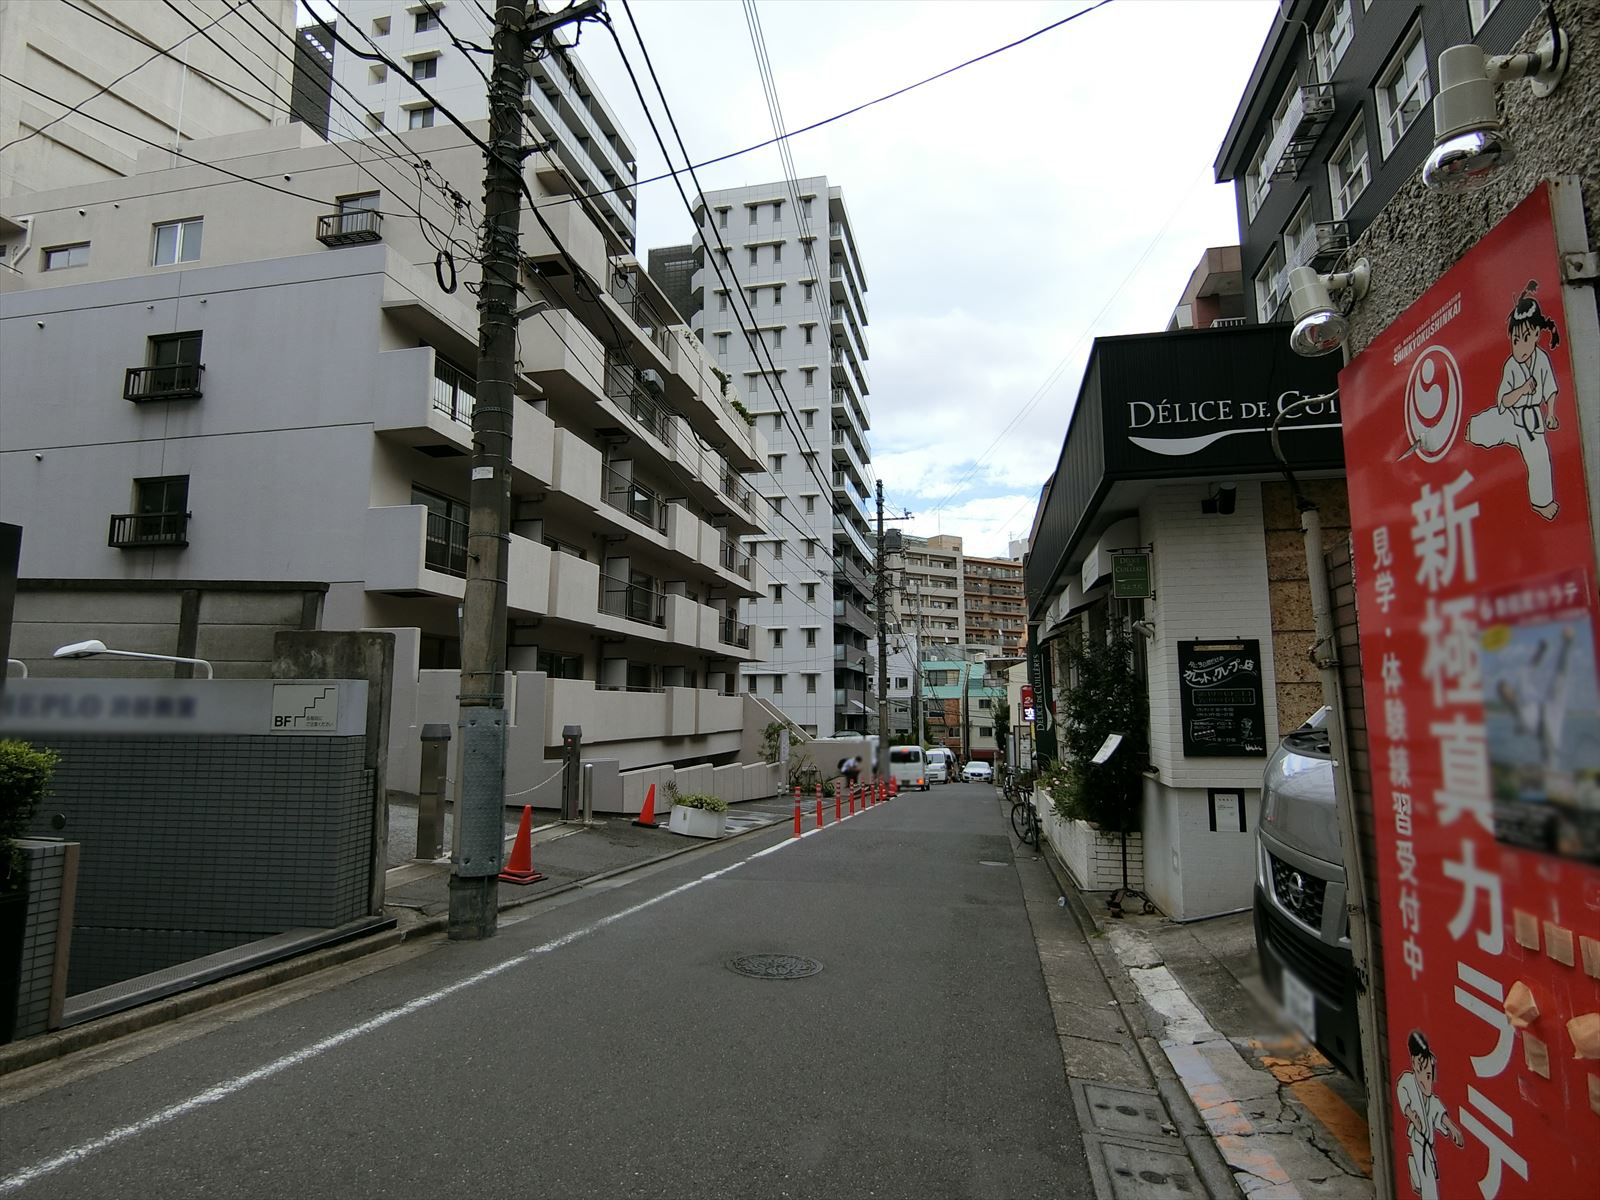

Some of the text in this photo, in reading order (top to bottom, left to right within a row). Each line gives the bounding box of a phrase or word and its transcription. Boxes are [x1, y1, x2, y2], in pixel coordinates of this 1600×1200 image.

[1393, 299, 1461, 366] SHINKYOKUSHINKAI
[1127, 398, 1233, 429] DÉLICE
[1240, 401, 1271, 420] DE
[274, 715, 292, 727] BF
